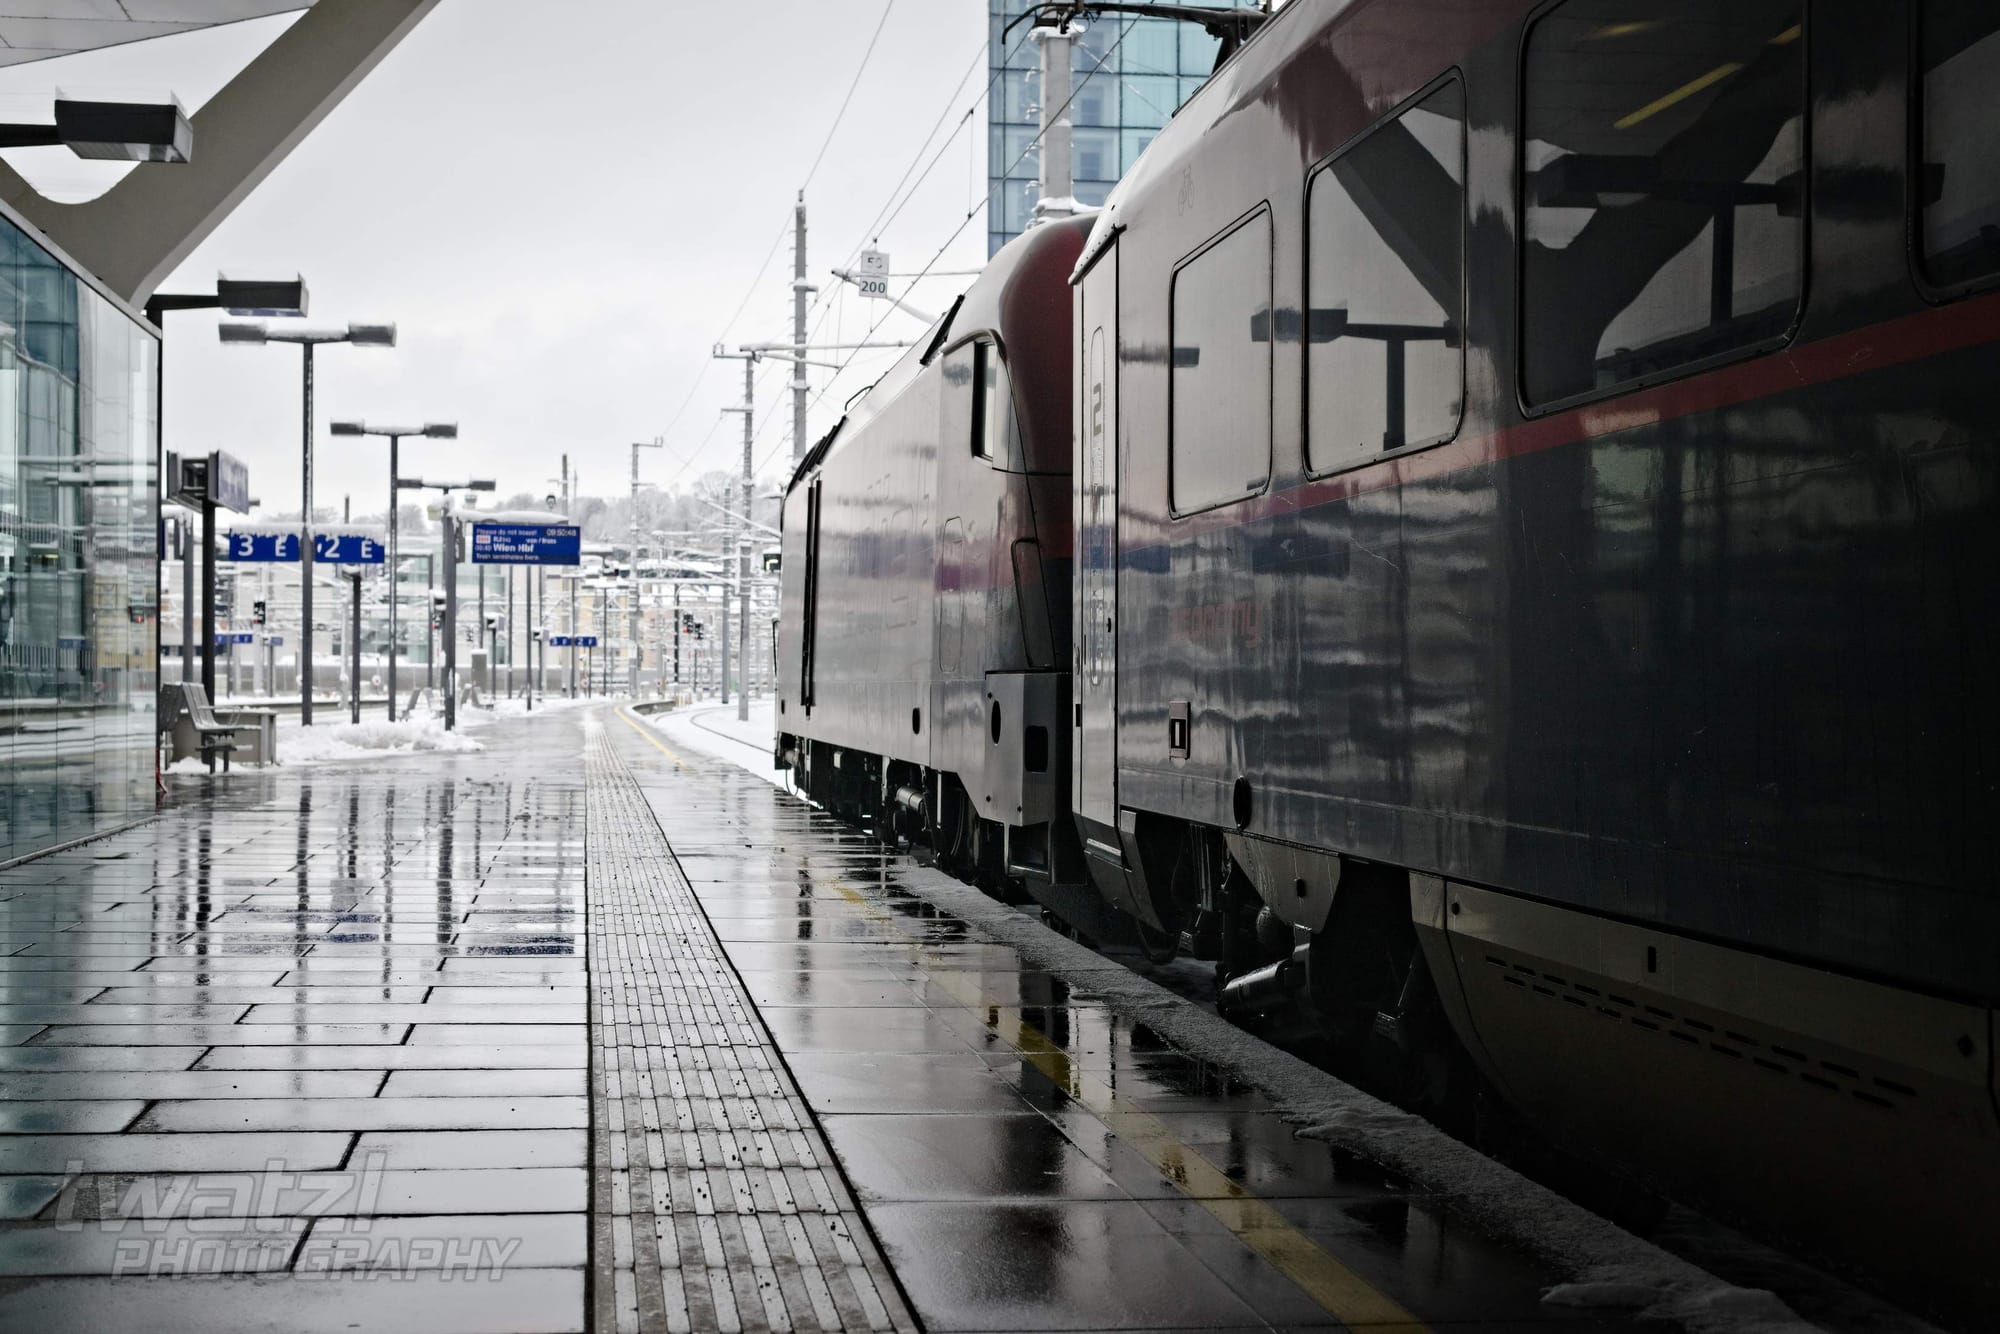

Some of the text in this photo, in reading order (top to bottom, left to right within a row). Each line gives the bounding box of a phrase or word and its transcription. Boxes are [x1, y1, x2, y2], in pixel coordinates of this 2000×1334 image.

[861, 281, 886, 294] 200
[1093, 382, 1102, 436] 2
[238, 534, 287, 557] 3 E
[324, 535, 373, 559] 2 E
[493, 543, 516, 552] Wien
[518, 544, 535, 553] Hbf
